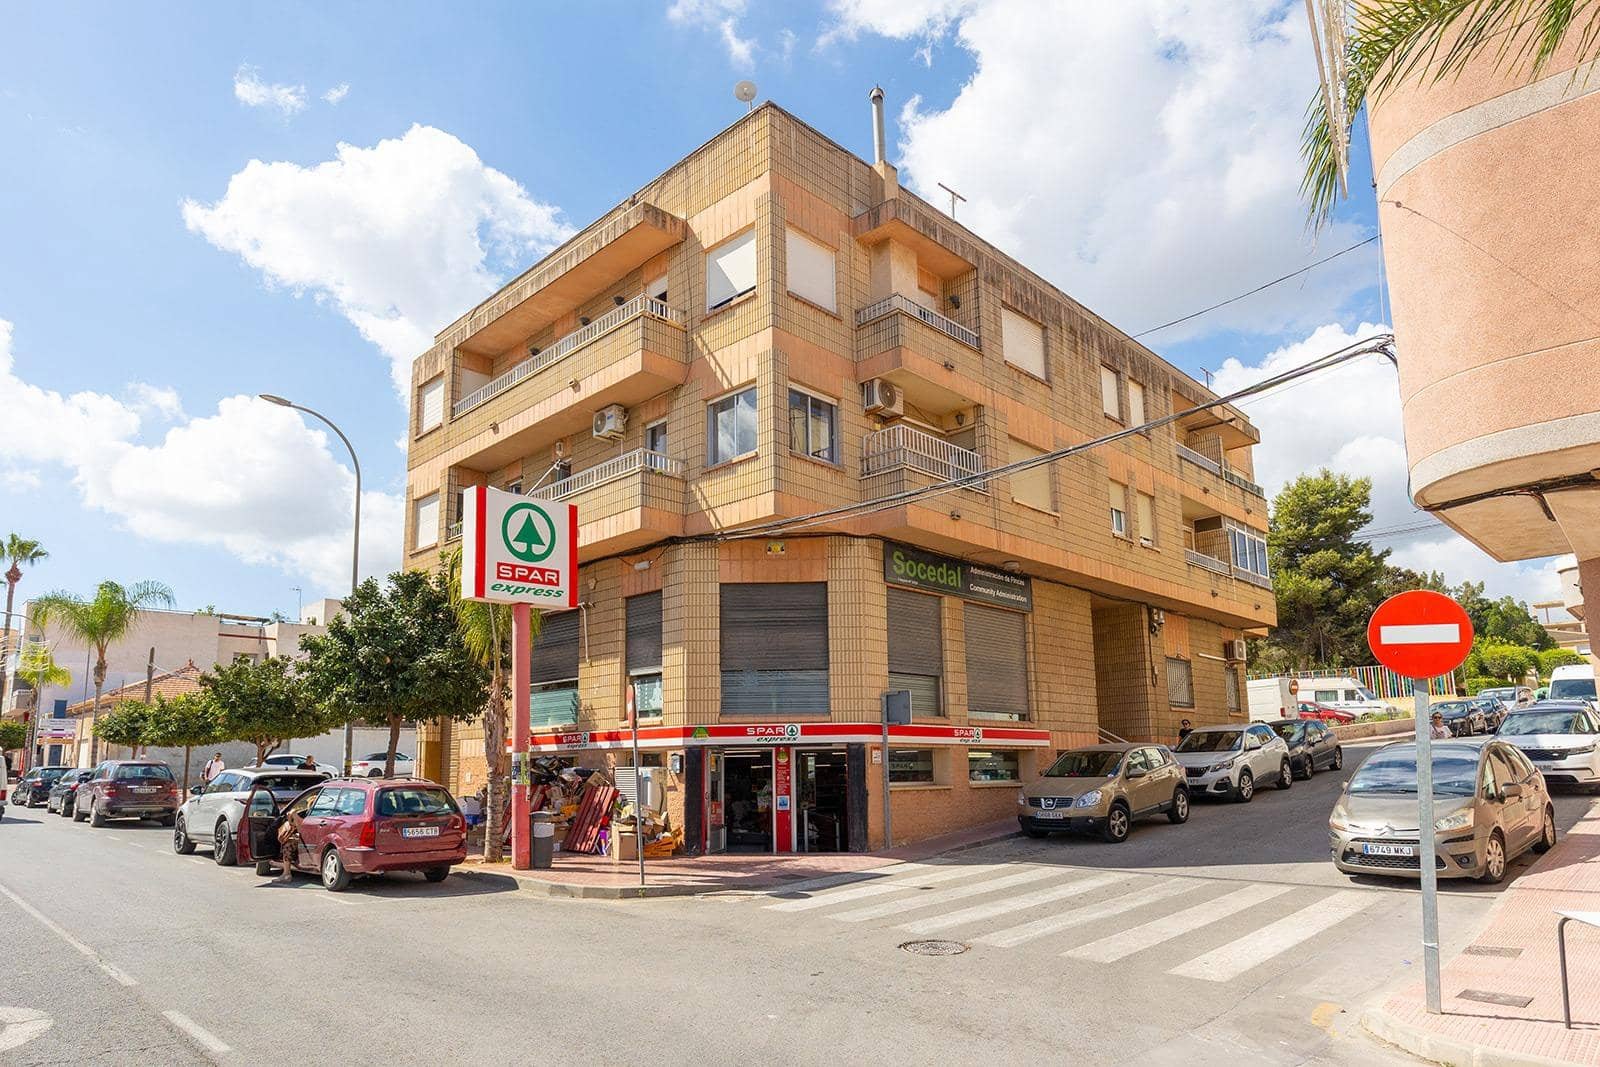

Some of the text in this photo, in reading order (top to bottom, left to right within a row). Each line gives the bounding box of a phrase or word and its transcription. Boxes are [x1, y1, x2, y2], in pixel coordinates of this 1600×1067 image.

[499, 565, 557, 584] SPAR
[892, 550, 961, 588] Socedal
[490, 582, 564, 598] express
[969, 583, 1028, 603] Community Administration
[746, 727, 785, 735] SPAR
[953, 729, 974, 737] SPAR
[562, 735, 582, 743] SPAR
[1394, 847, 1411, 855] MKJ
